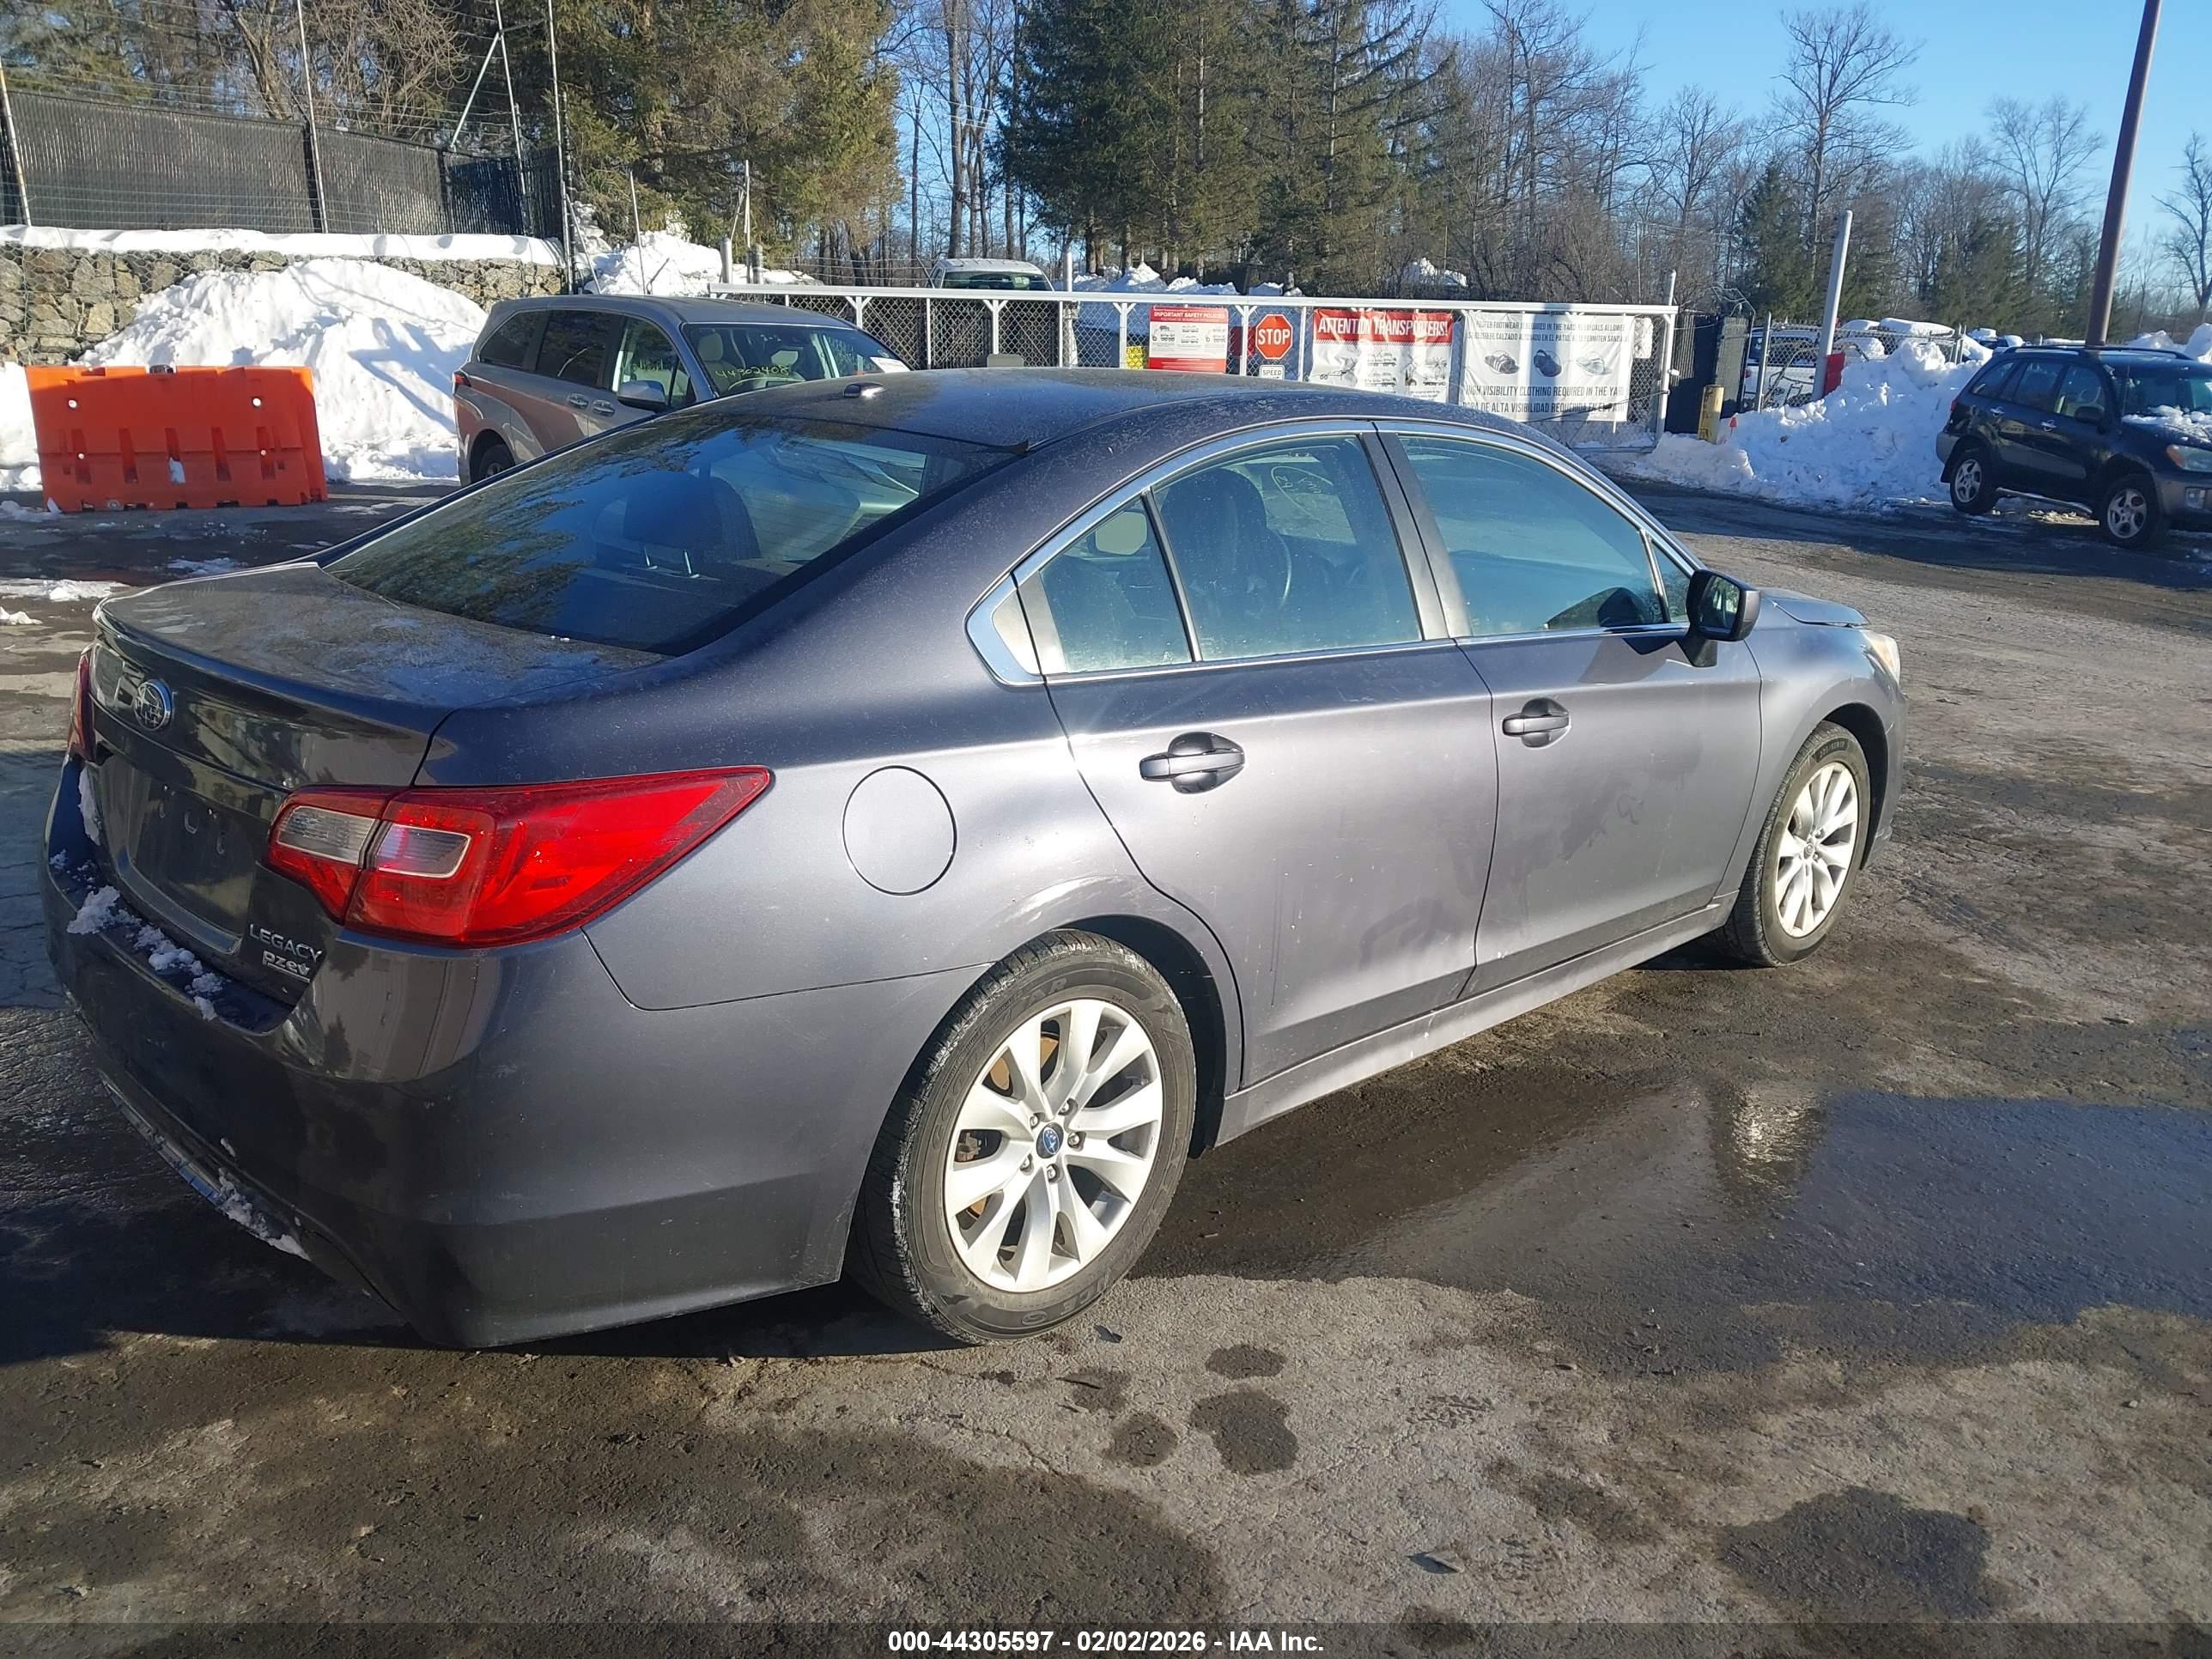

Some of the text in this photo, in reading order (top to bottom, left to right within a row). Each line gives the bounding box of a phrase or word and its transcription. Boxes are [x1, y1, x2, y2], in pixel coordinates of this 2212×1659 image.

[1318, 317, 1449, 337] ATTENTION TRANSPORTERS!
[1258, 328, 1291, 345] STOP
[1483, 386, 1518, 396] VISIBILITY
[1519, 386, 1552, 397] CLOTHING
[1553, 386, 1585, 397] REQUIRED
[1586, 386, 1593, 397] IN
[1595, 386, 1607, 397] THE
[1481, 402, 1491, 412] DE
[1491, 402, 1509, 413] ALTA
[1511, 403, 1550, 413] VISIBILIDAD
[249, 923, 323, 963] LEGACY
